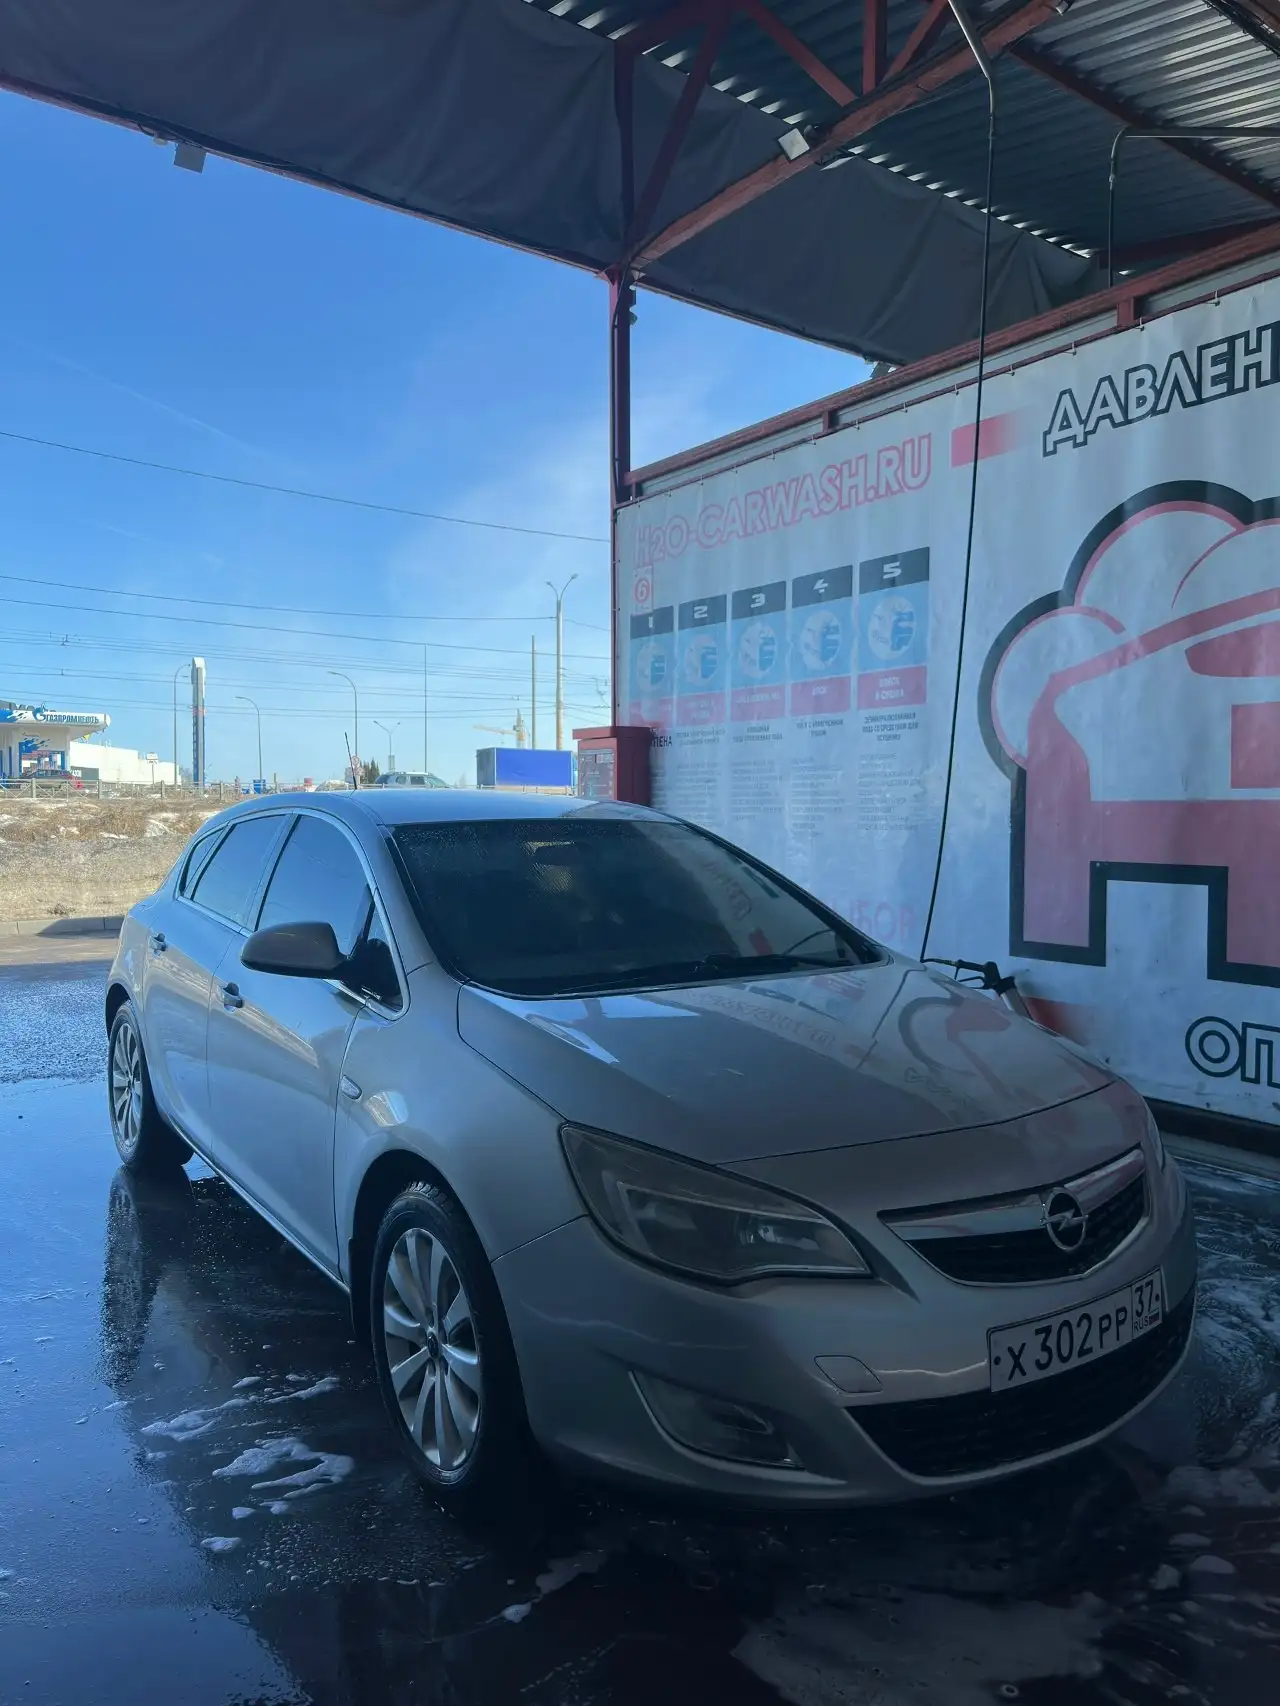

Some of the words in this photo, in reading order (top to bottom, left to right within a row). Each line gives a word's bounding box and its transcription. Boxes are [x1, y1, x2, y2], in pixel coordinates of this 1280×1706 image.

[1043, 320, 1280, 457] ДАВЛЕН
[635, 435, 931, 566] H2O-CARWASH.RU
[883, 562, 902, 579] 5
[813, 578, 828, 593] 4
[750, 593, 766, 608] 3
[694, 605, 708, 619] 2
[648, 616, 653, 628] 1
[46, 714, 99, 724] ГАЗПРОМНЕФТЬ
[1134, 1279, 1154, 1318] 37
[1134, 1316, 1149, 1333] RUS
